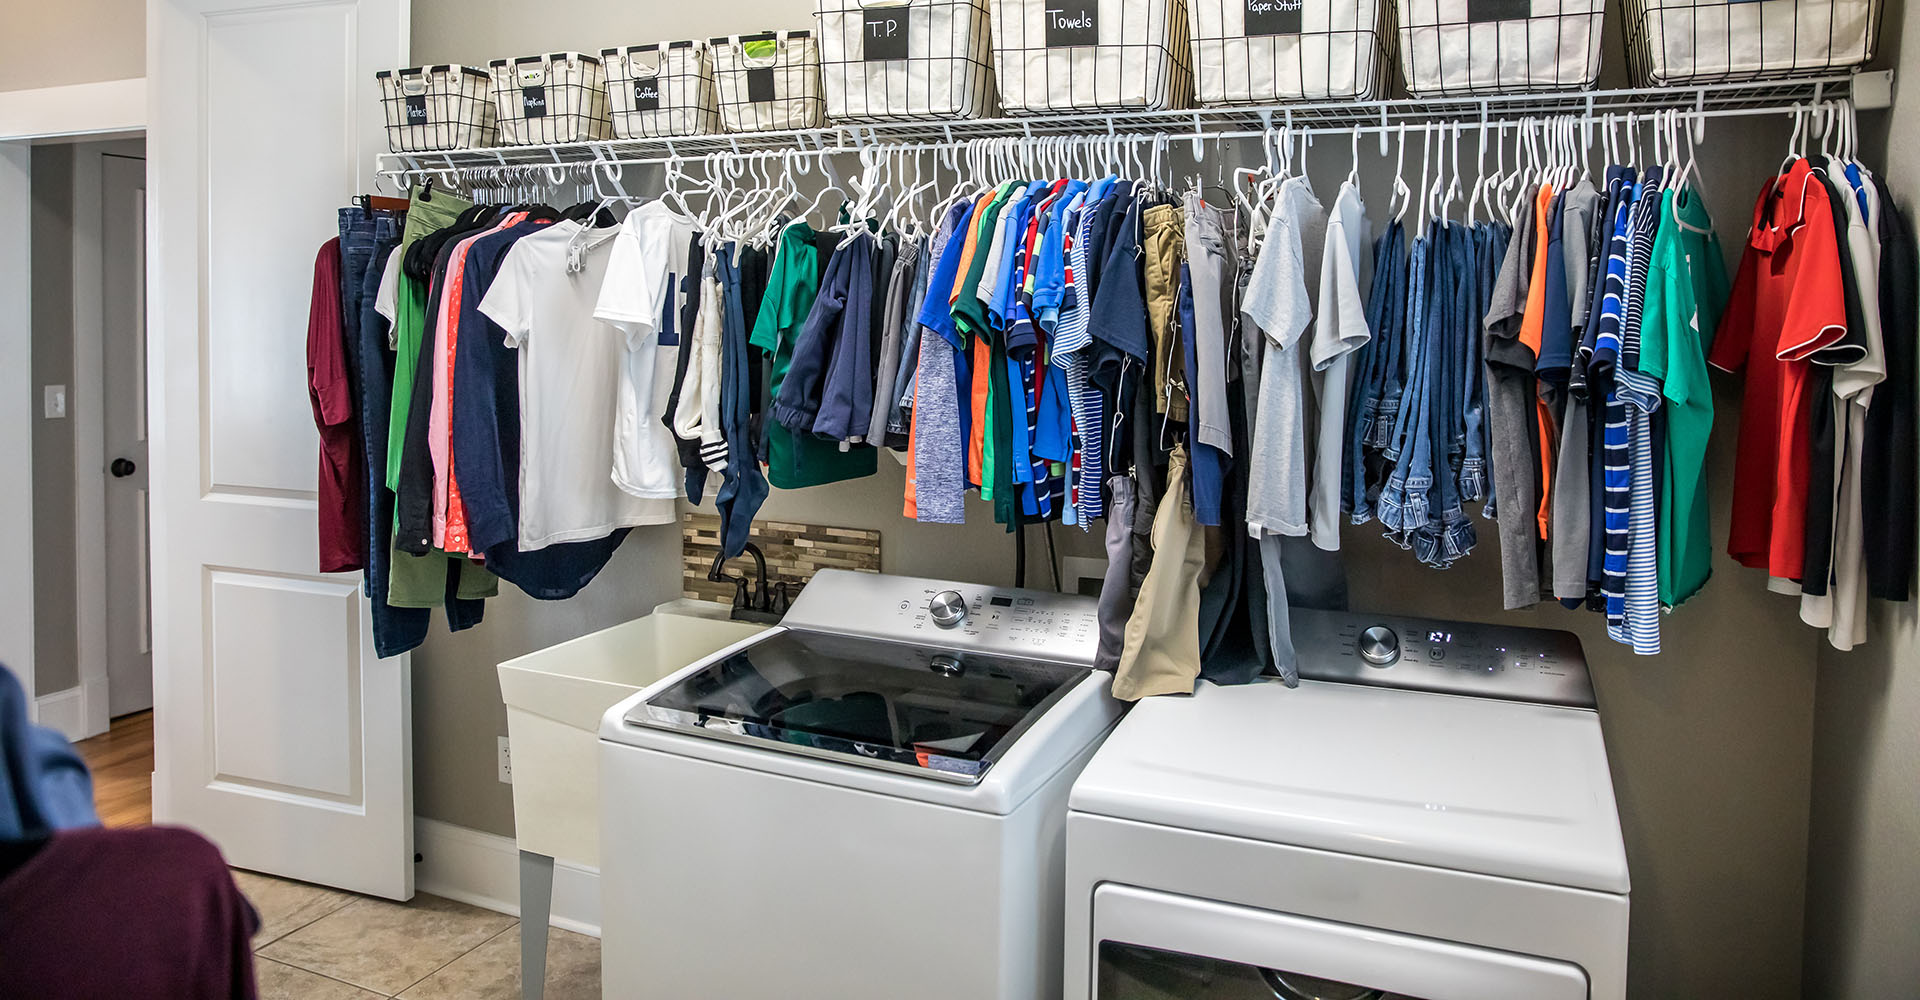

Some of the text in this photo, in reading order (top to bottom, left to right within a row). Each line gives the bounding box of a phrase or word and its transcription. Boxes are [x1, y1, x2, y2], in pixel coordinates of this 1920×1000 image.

[1247, 0, 1273, 15] Paper
[1045, 9, 1092, 29] Towels
[866, 19, 897, 38] T.P.
[635, 86, 658, 99] Coffee
[406, 104, 427, 118] Plates
